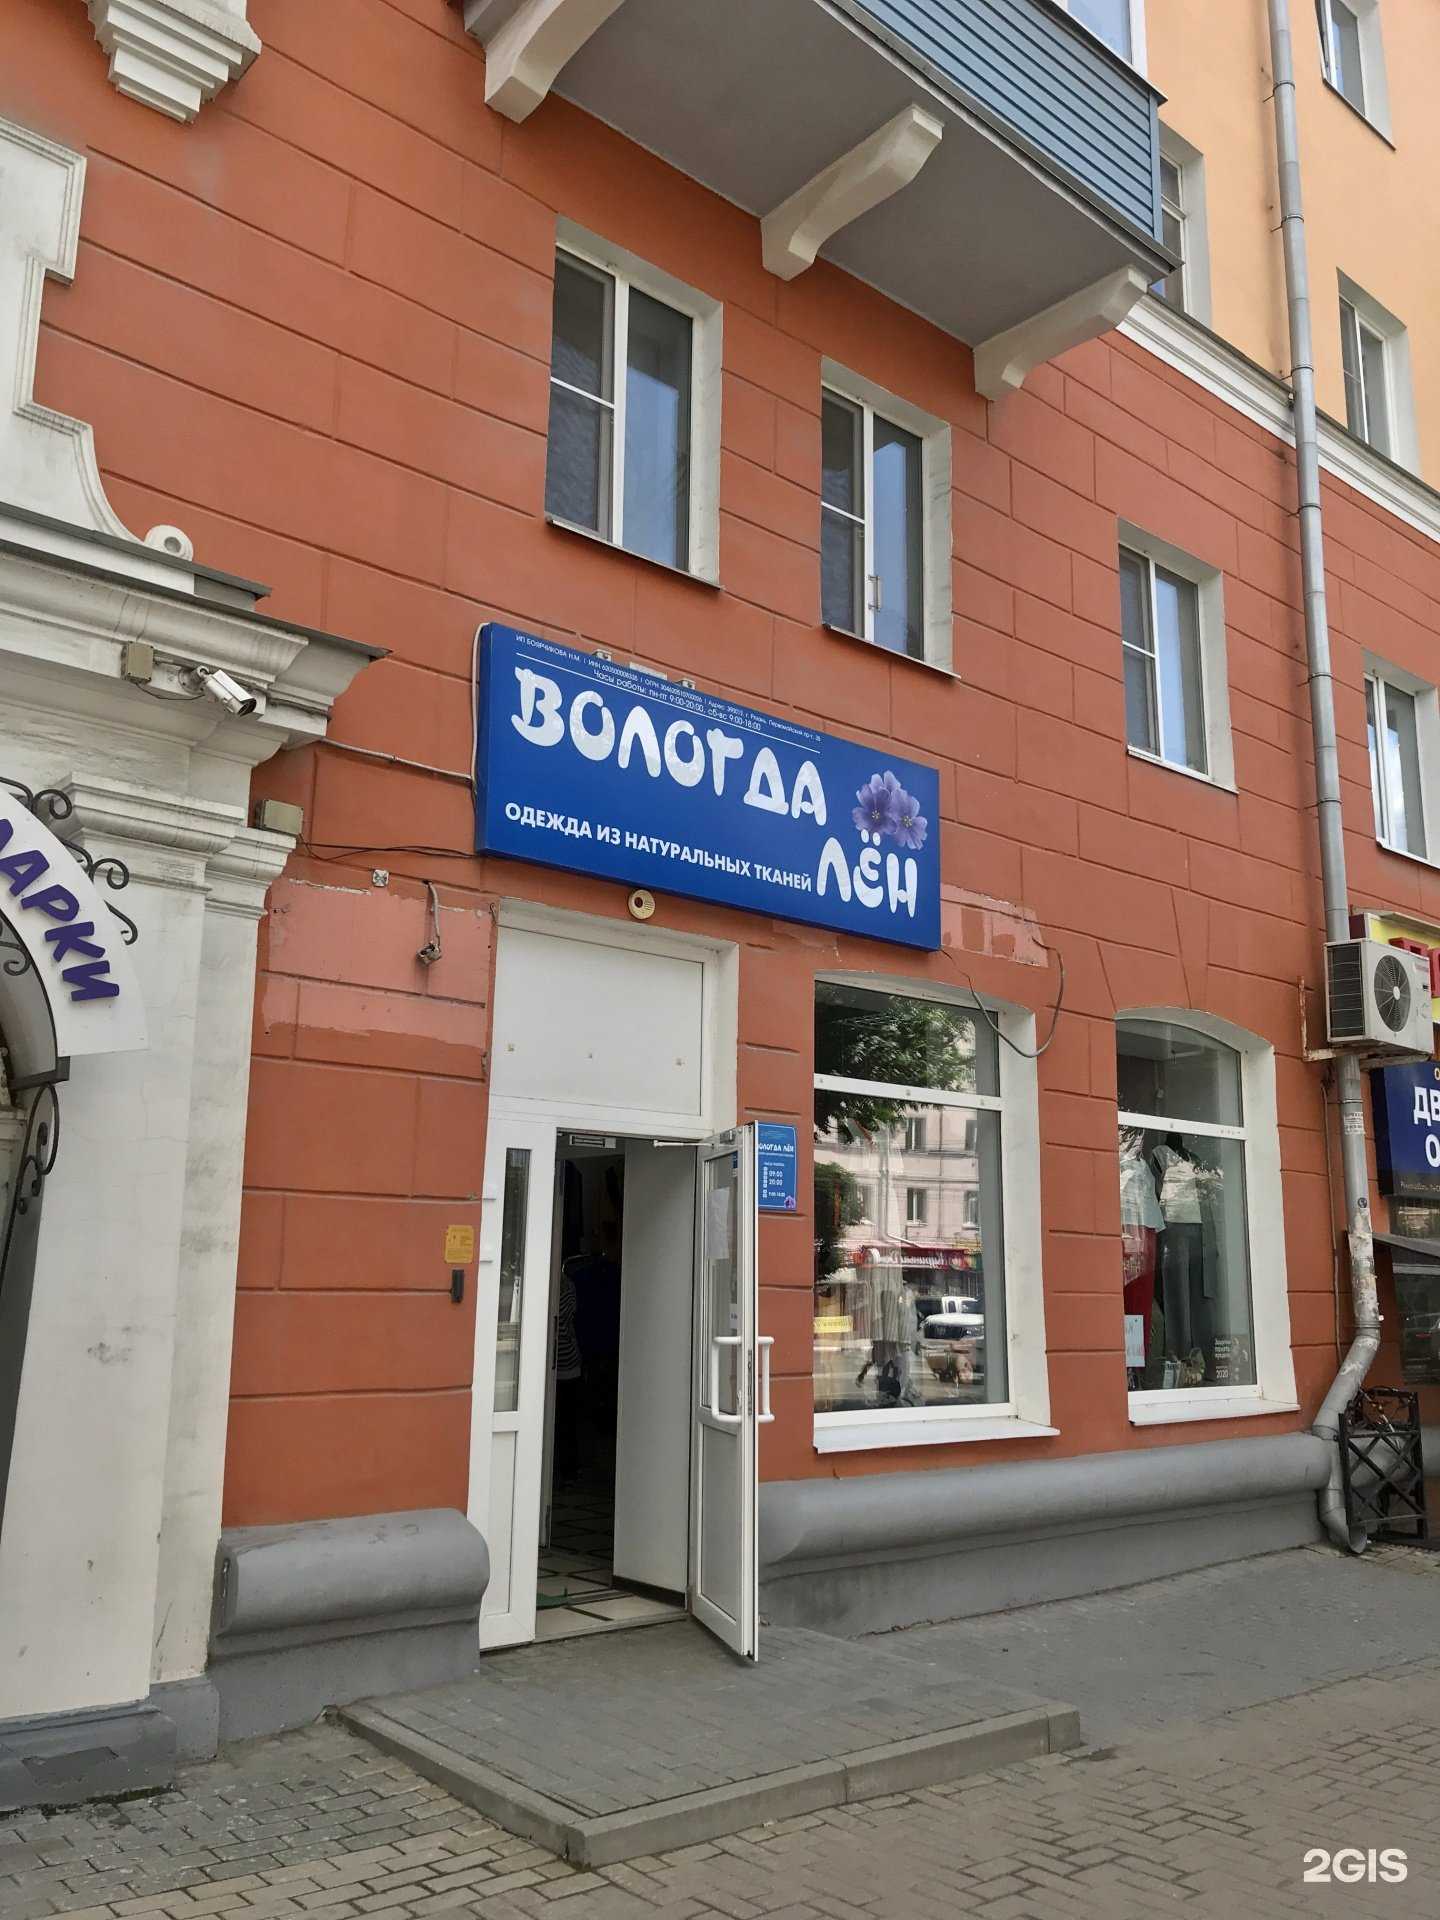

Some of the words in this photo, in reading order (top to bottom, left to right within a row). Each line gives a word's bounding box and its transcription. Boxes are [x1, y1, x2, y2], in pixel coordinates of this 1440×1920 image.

[515, 634, 525, 643] ИП
[593, 669, 615, 684] Часы
[616, 678, 647, 696] работы:
[649, 689, 669, 701] пн-пт
[708, 708, 728, 720] сб-вс
[511, 667, 827, 826] ВОЛОГДА
[505, 802, 592, 838] ОДЕЖДА
[597, 824, 621, 845] ИЗ
[625, 831, 751, 878] НАТУРАЛЬНЫХ
[754, 864, 812, 892] ТКАНЕЙ
[816, 829, 918, 918] ЛЁН
